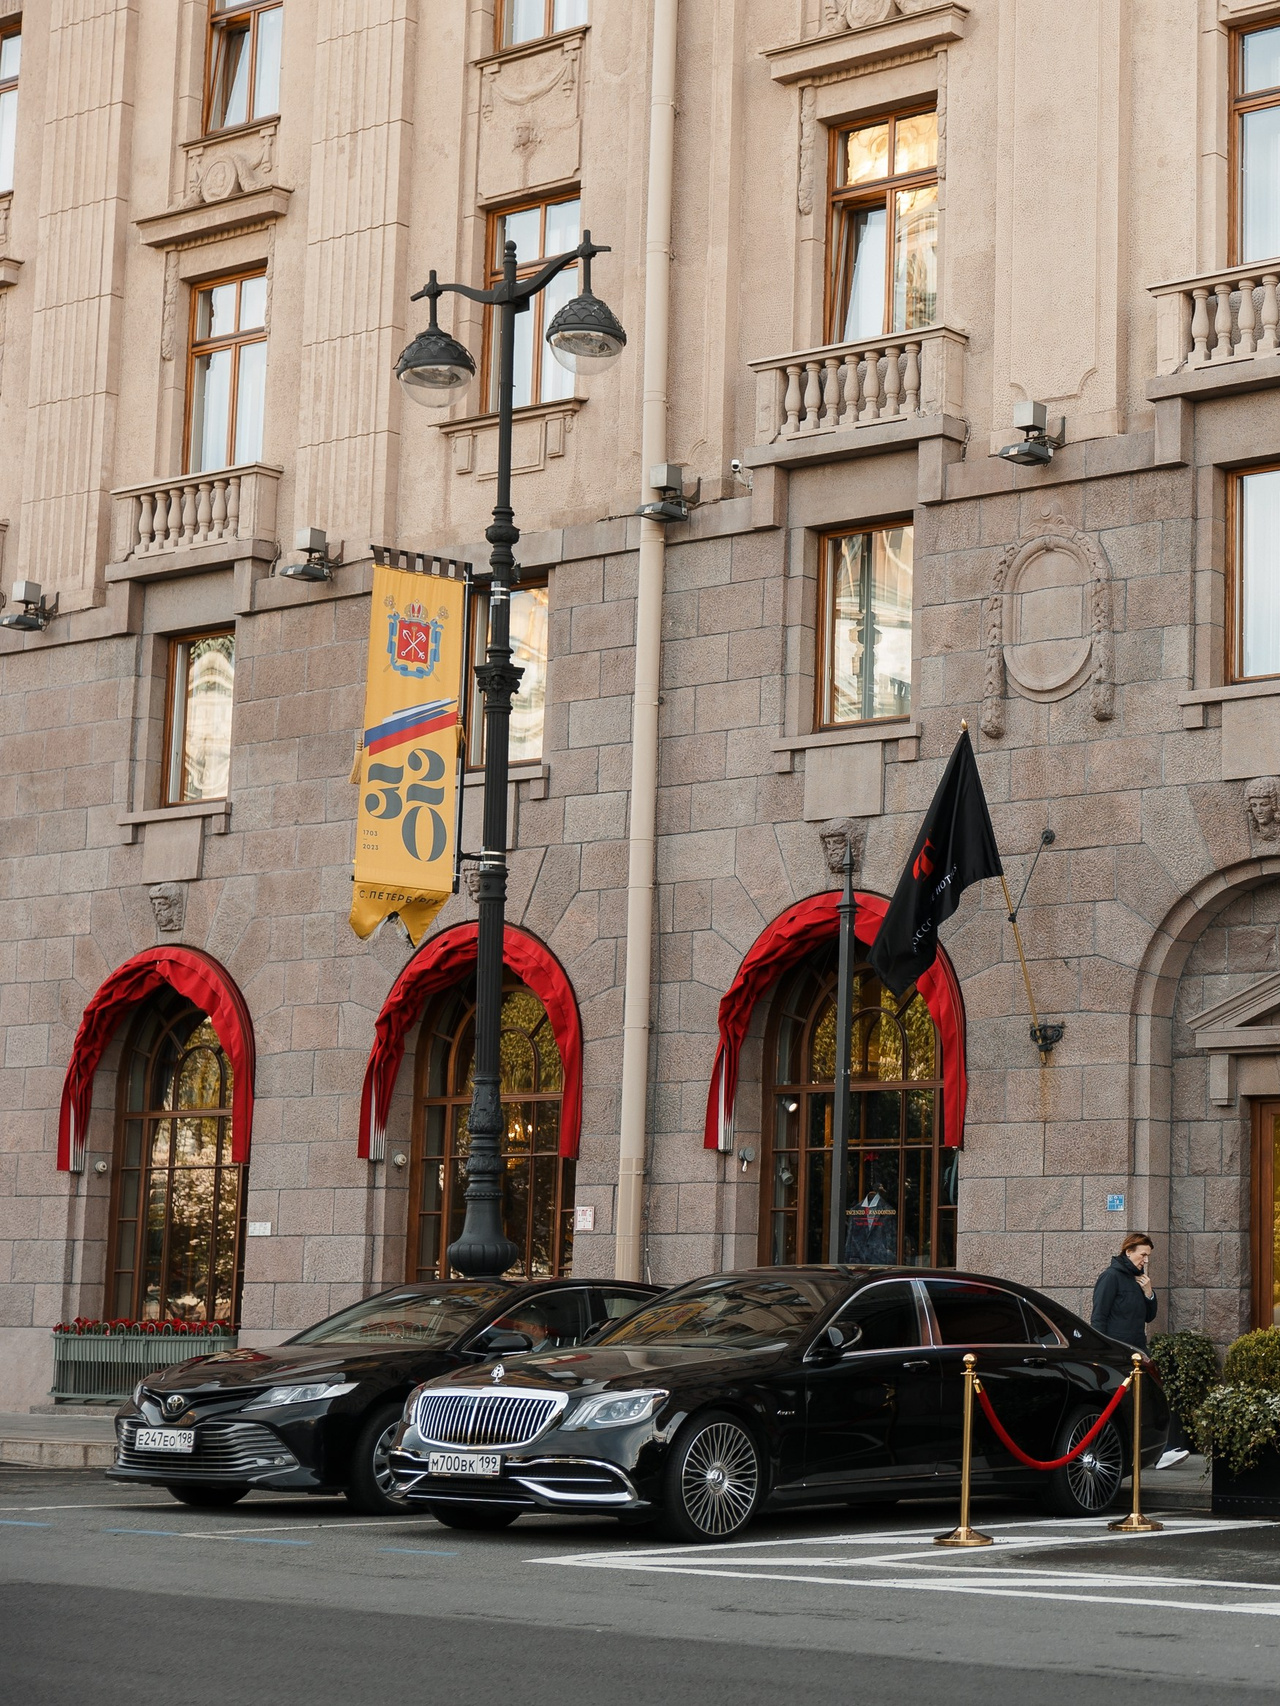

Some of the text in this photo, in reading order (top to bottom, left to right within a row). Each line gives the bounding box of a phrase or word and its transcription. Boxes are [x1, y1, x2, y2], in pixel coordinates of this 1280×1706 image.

[362, 843, 379, 851] 2023
[177, 1432, 193, 1444] 198
[479, 1456, 497, 1469] 199
